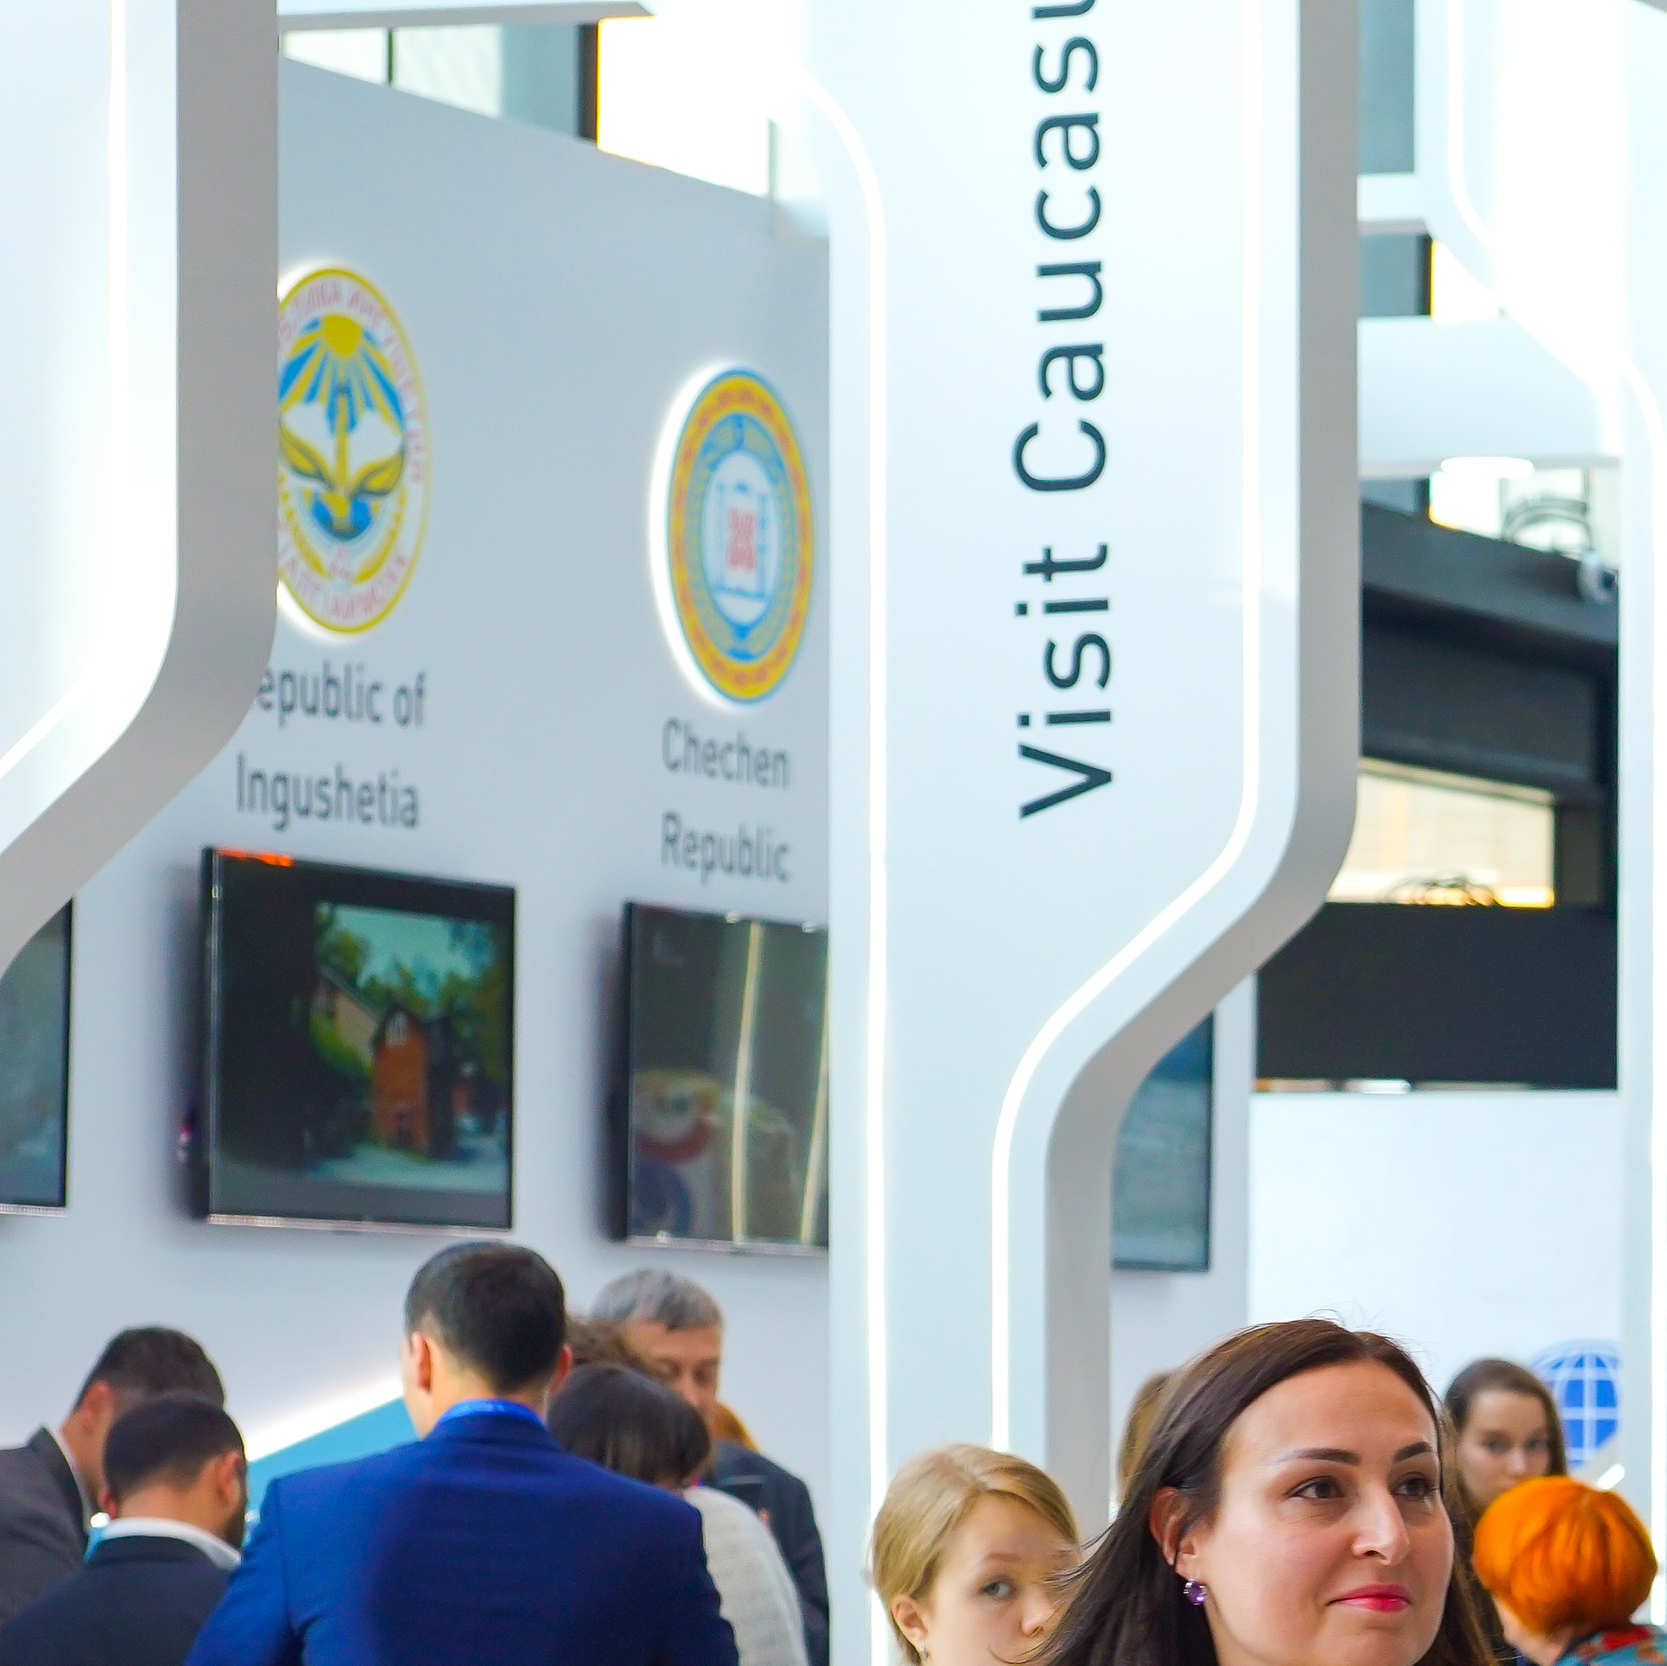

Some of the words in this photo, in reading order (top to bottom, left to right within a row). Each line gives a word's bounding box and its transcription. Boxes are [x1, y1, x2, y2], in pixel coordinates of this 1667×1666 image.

[1011, 0, 1109, 493] Caucas
[255, 657, 383, 728] epublic
[393, 670, 427, 728] of
[1014, 543, 1113, 820] Visit
[236, 751, 420, 832] Ingushetia
[662, 716, 792, 791] Chechen
[660, 809, 792, 885] Republic
